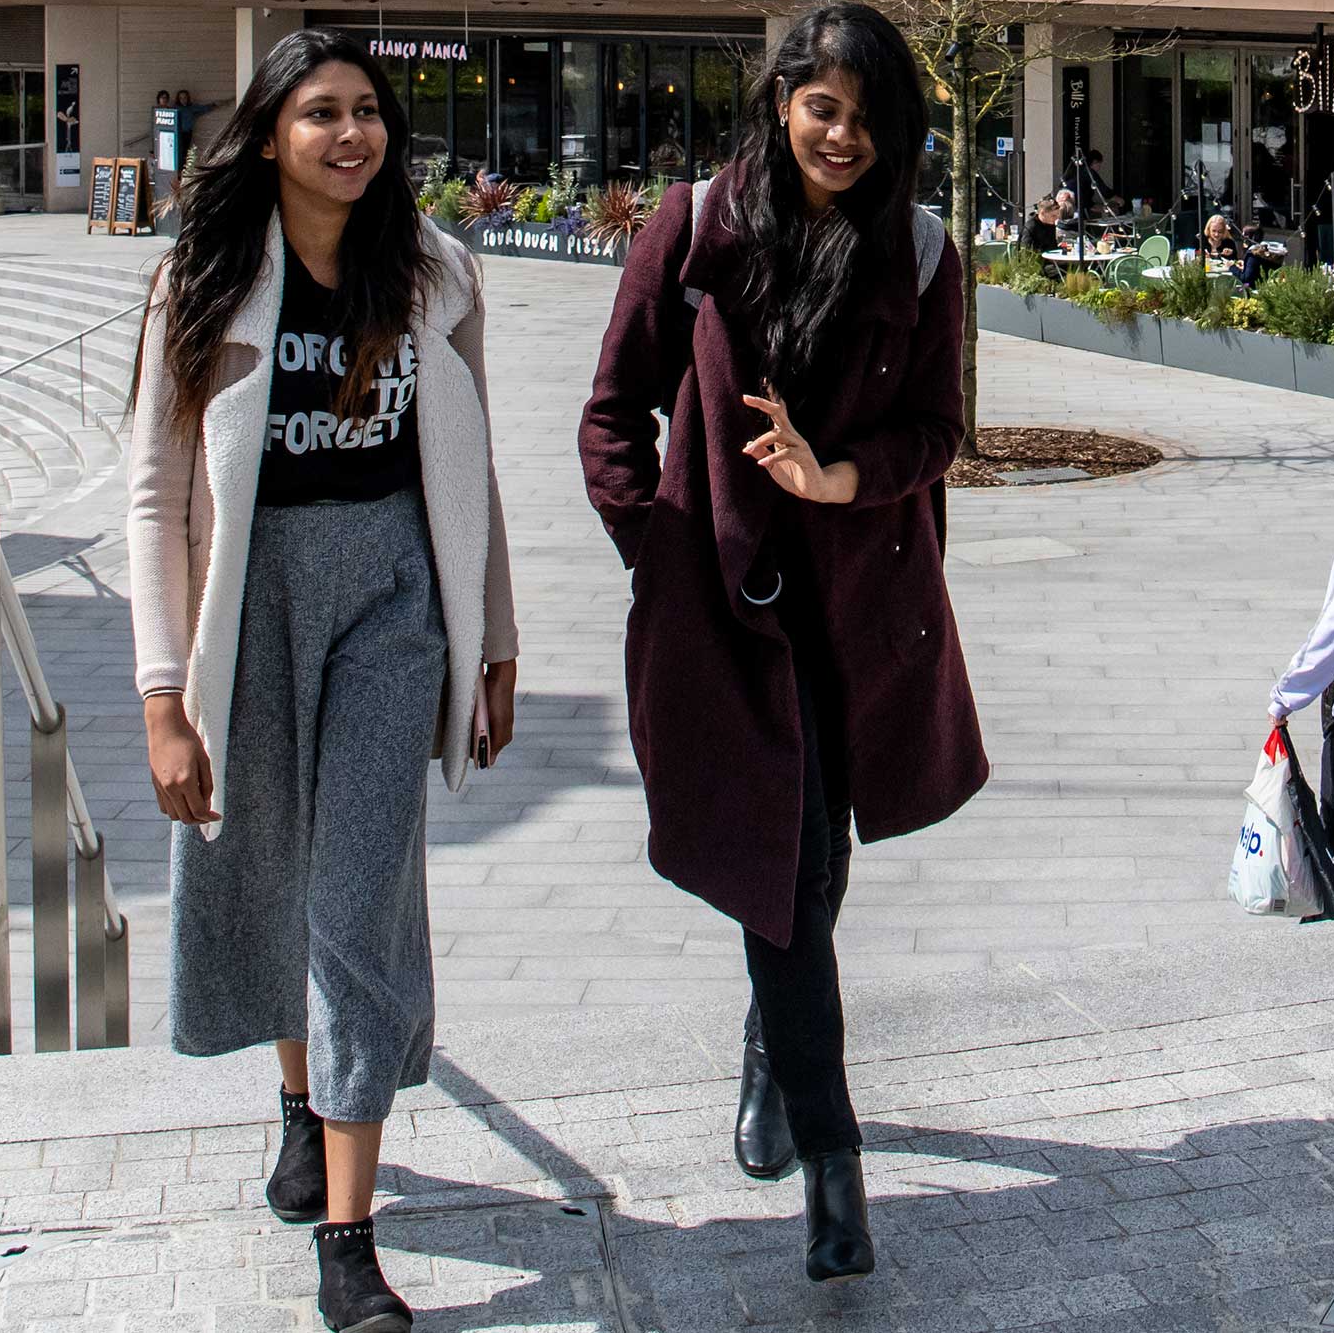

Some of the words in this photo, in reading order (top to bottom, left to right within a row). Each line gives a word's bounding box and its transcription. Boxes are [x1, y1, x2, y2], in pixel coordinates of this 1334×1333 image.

[369, 40, 417, 59] FRANCO
[421, 41, 468, 61] MANCA
[1070, 79, 1085, 109] Bill's
[482, 228, 558, 252] SOURDOUGH
[567, 234, 614, 258] PIZZA
[371, 373, 417, 415] TO
[264, 405, 409, 455] FORGET
